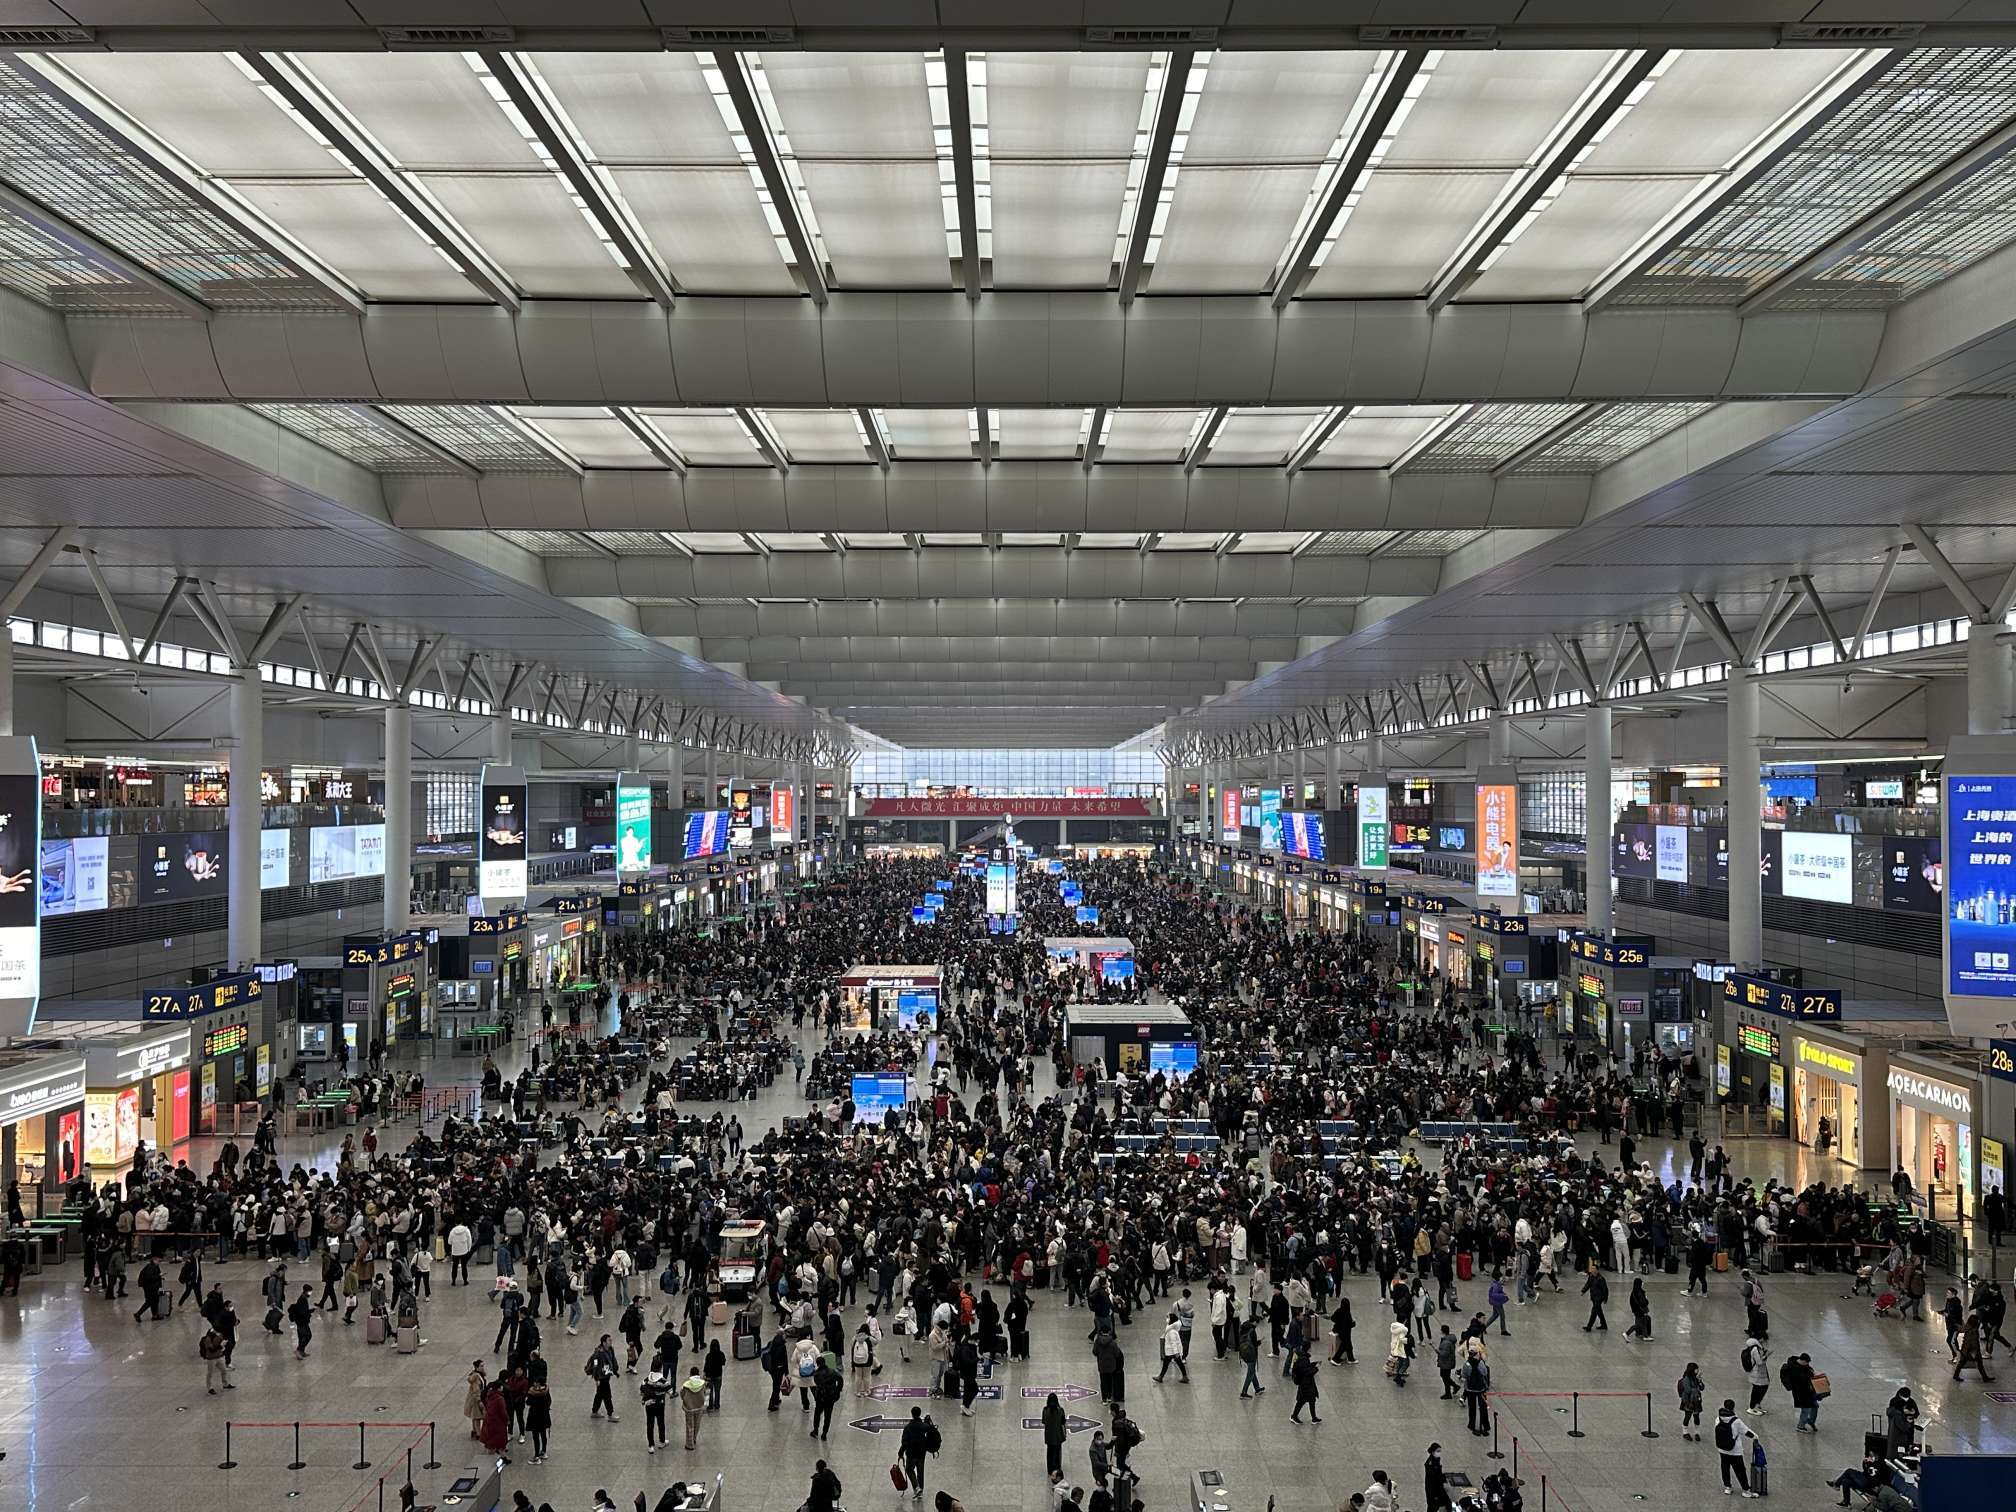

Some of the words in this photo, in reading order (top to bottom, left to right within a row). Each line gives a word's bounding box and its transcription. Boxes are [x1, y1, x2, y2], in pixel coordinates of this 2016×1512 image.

[326, 782, 353, 798] 永和大王
[1971, 831, 2013, 843] 上海的
[1969, 853, 2012, 865] 世界的
[622, 885, 637, 894] 19A
[1369, 884, 1383, 894] 19B
[559, 901, 576, 910] 21A
[1426, 900, 1443, 910] 21B
[473, 921, 494, 932] 23A
[1504, 920, 1525, 932] 23B
[348, 950, 373, 963] 25A
[1619, 950, 1644, 963] 25B
[150, 997, 181, 1013] 27A
[188, 994, 204, 1013] 27A
[1780, 993, 1796, 1013] 27B
[1803, 997, 1835, 1014] 27B
[1992, 1048, 2013, 1072] 28B
